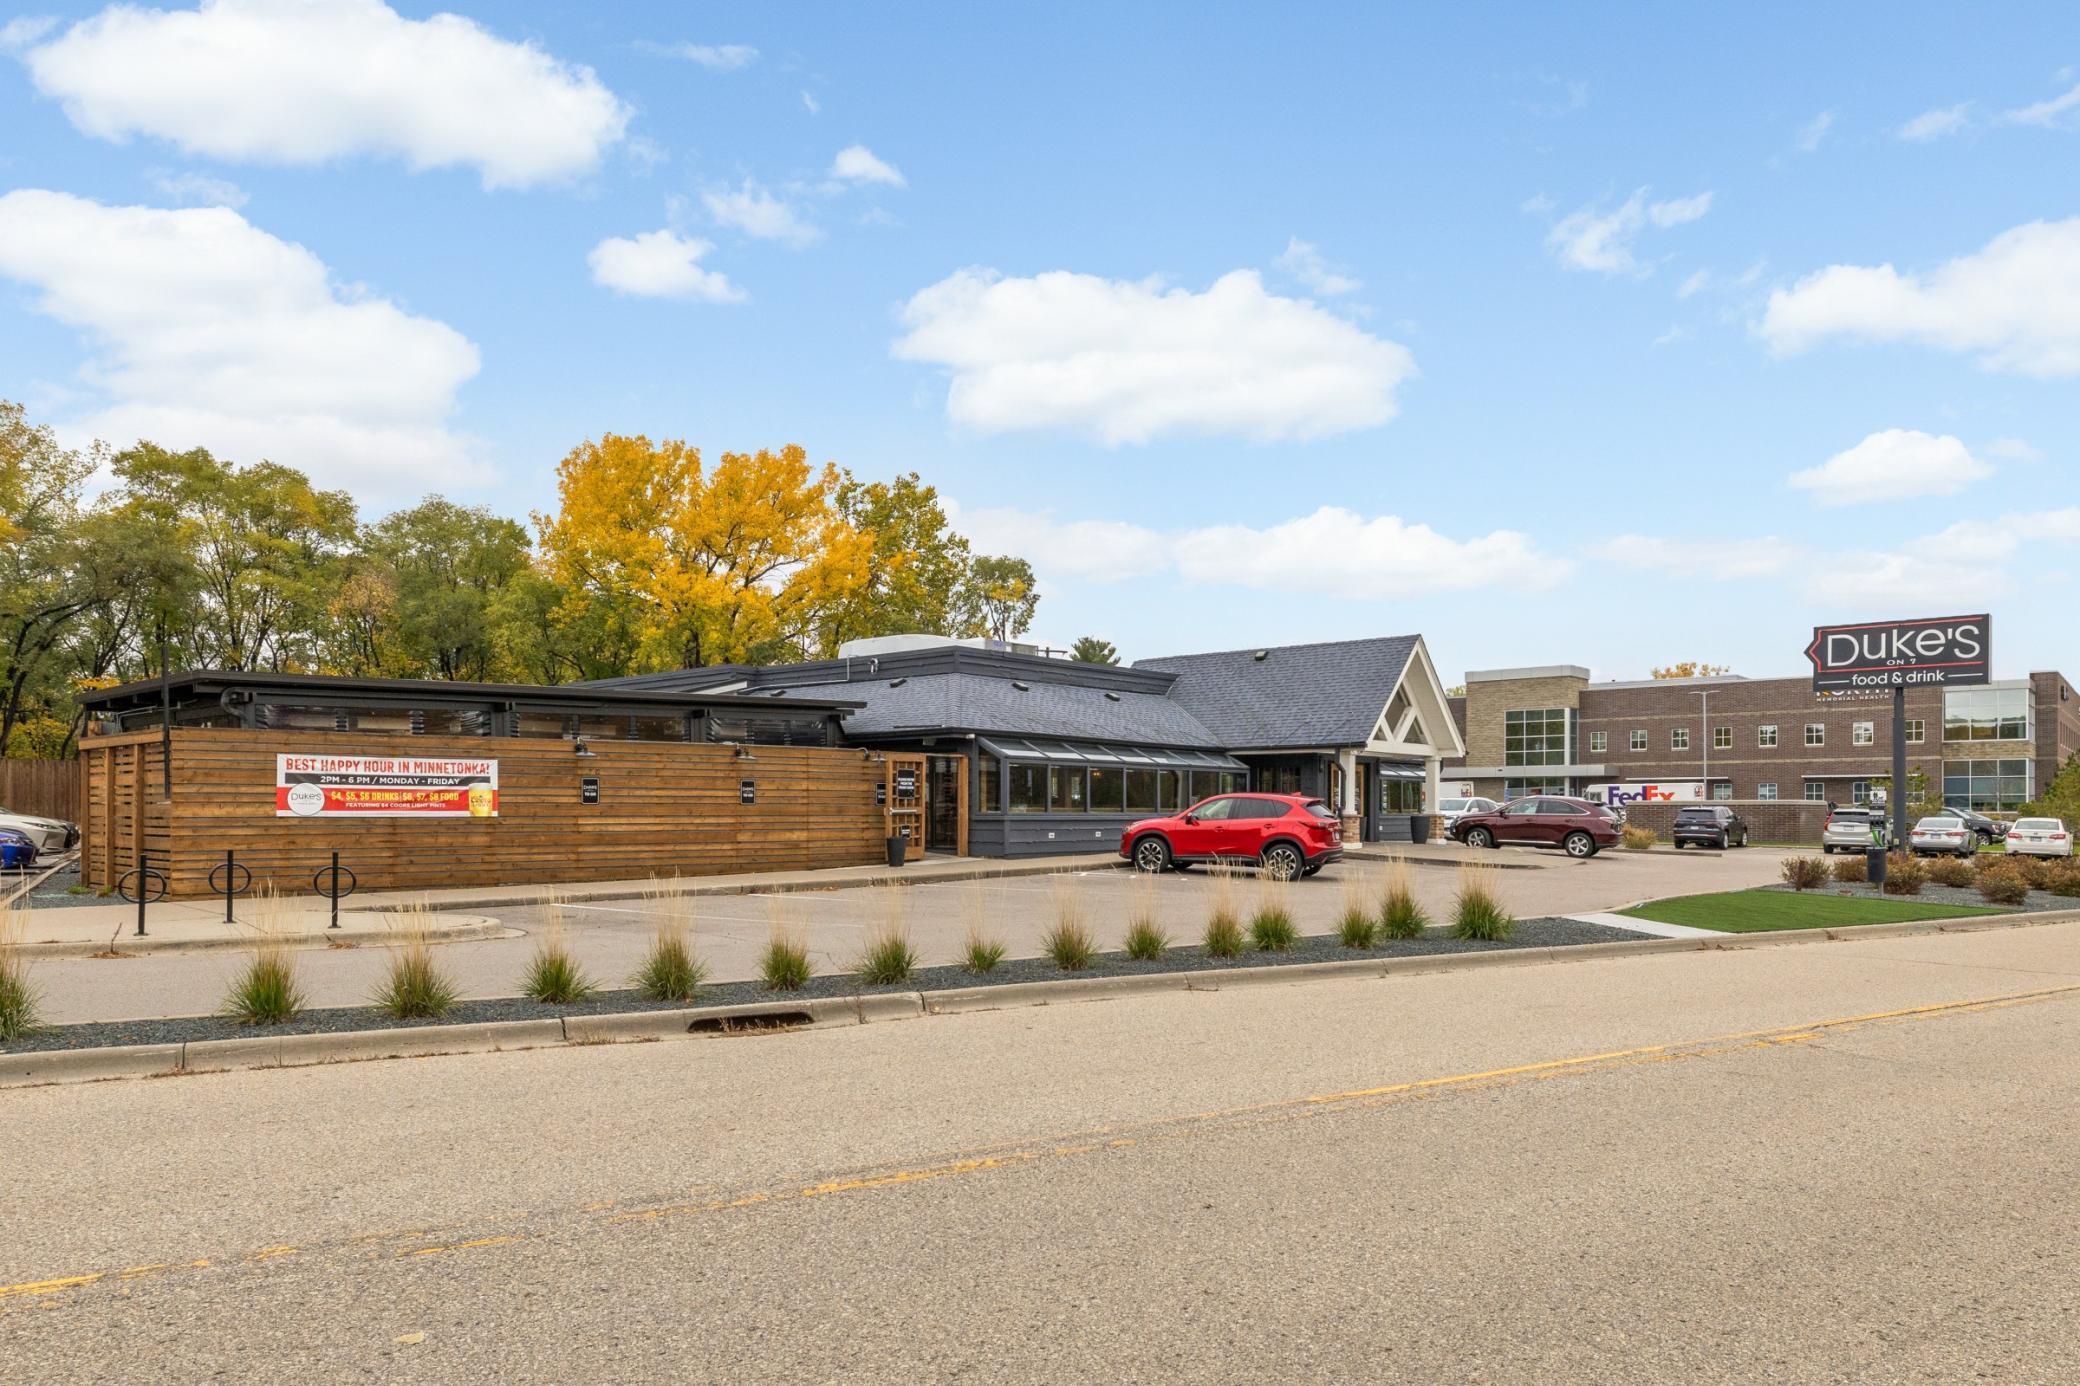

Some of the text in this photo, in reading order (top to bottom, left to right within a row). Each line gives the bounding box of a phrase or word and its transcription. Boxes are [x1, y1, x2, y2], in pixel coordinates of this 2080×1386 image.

[1852, 669, 1945, 686] food & drink
[286, 758, 490, 775] BEST HAPPY HOUR IN MINNETONKA!
[320, 776, 340, 784] 2PM
[348, 776, 354, 784] 6
[356, 776, 370, 784] PM
[379, 777, 420, 785] MONDAY
[371, 792, 399, 801] DRINKS
[440, 792, 459, 801] FOOD
[1607, 785, 1675, 806] FedEx
